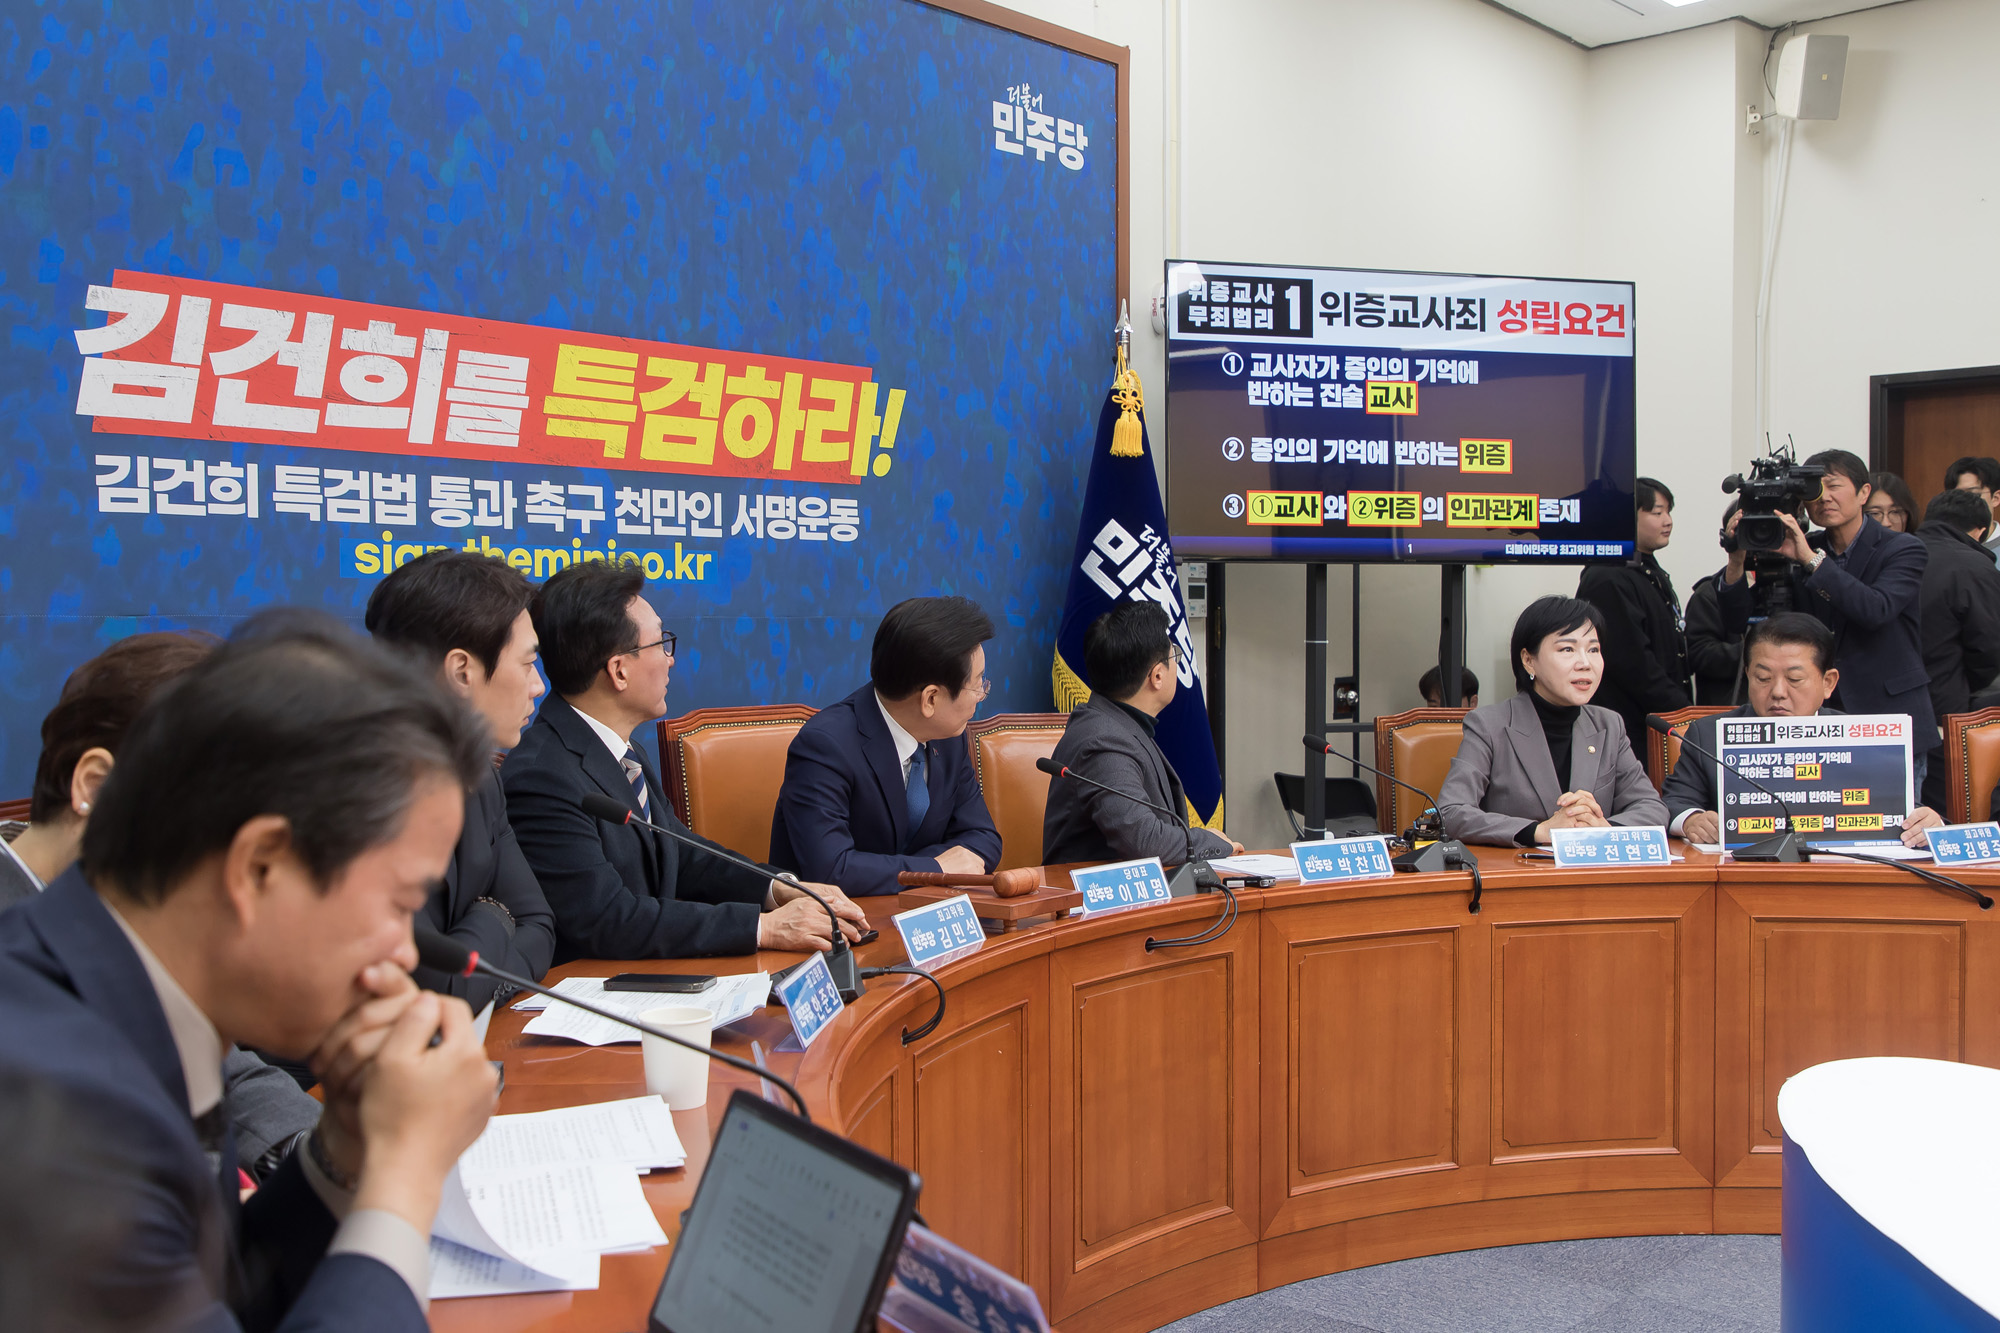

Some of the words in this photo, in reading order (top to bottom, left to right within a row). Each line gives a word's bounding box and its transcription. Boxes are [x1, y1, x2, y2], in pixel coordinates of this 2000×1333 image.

[1006, 82, 1043, 112] 더불어
[992, 100, 1089, 171] 민주당
[1188, 280, 1275, 305] 위증교사
[1188, 305, 1274, 330] 무죄법리
[1285, 285, 1301, 330] 1
[1319, 291, 1486, 333] 위증교사죄
[1497, 299, 1626, 338] 성립요건
[73, 284, 530, 448] 김건희를
[543, 343, 907, 478] 특검하라!
[1250, 353, 1340, 380] 교사자가
[1344, 355, 1410, 382] 증인의
[1415, 358, 1479, 385] 기억에
[1247, 380, 1314, 407] 반하는
[1319, 383, 1364, 409] 진술
[1369, 385, 1414, 409] 교사
[1250, 436, 1318, 464] 증인의
[1323, 439, 1389, 465] 기억에
[1394, 440, 1459, 467] 반하는
[1464, 443, 1506, 466] 위증
[95, 454, 259, 518] 김건희
[272, 464, 417, 526] 특검법
[428, 475, 518, 530] 통과
[525, 480, 606, 534] 촉구
[614, 486, 723, 538] 천만인
[730, 494, 860, 542] 서명운동
[1450, 498, 1533, 522] 인과관계
[1539, 498, 1581, 524] 존재
[1505, 543, 1559, 556] 더불어민주당
[1559, 544, 1595, 556] 최고위원
[1764, 724, 1771, 742] 1
[1777, 724, 1844, 739] 위증교사죄
[1848, 723, 1902, 738] 성립요건
[1739, 753, 1782, 766] 교사자가
[1819, 751, 1852, 764] 기억에
[1772, 765, 1794, 778] 진술
[1796, 766, 1819, 777] 교사
[1808, 790, 1842, 803] 반하는
[1844, 790, 1865, 802] 위증
[1837, 815, 1880, 828] 인과관계
[1882, 814, 1904, 828] 존재
[1340, 842, 1375, 855] 원내대표
[1610, 831, 1652, 842] 최고위원
[1564, 844, 1597, 858] 민주당
[1603, 843, 1663, 862] 전현희
[1936, 842, 1961, 857] 민주당
[1123, 866, 1148, 881] 당대표
[1304, 857, 1333, 874] 민주당
[1337, 853, 1387, 875] 박찬대
[1086, 885, 1115, 903] 민주당
[1118, 878, 1165, 902] 이재명
[937, 917, 980, 949] 김민석
